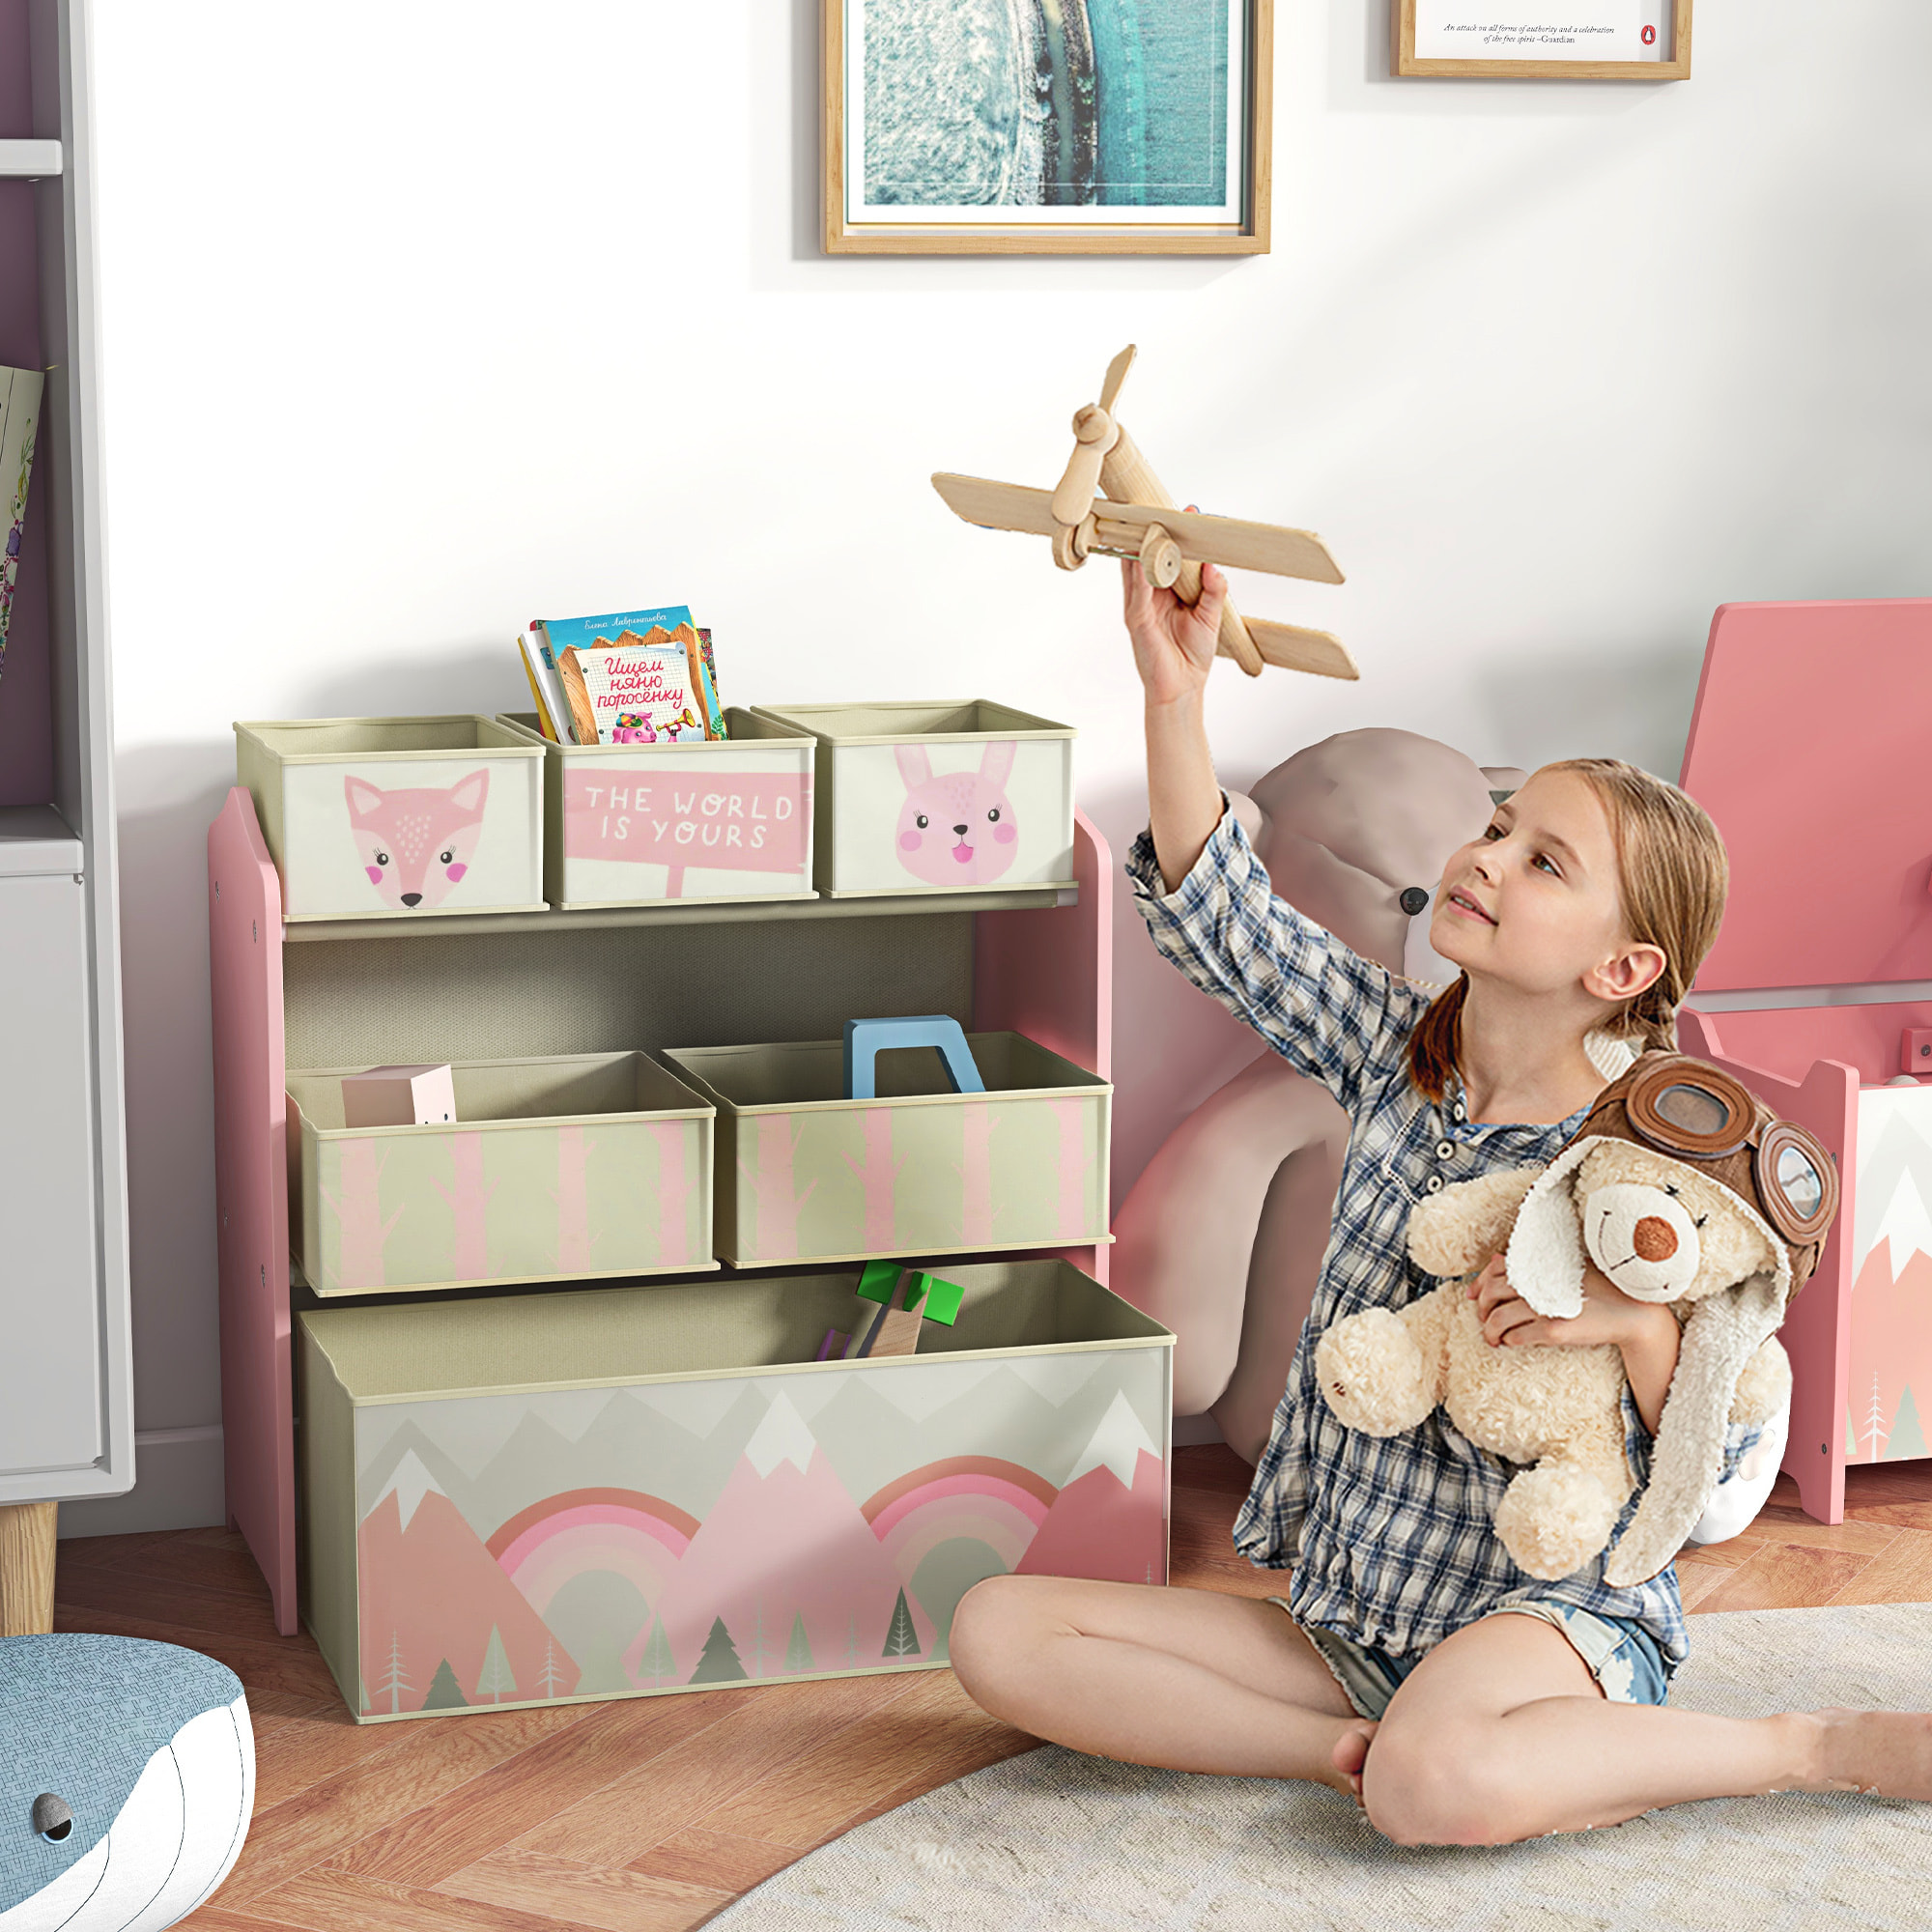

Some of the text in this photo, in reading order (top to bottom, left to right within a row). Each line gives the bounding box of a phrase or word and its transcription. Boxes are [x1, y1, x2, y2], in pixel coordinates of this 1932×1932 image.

[1443, 23, 1455, 32] An
[1497, 24, 1518, 34] forms
[1519, 25, 1527, 34] of
[1526, 25, 1557, 35] authority
[1483, 35, 1492, 44] of
[1502, 35, 1516, 44] free
[1517, 35, 1536, 44] spirit
[584, 619, 609, 631] Елена
[605, 657, 665, 677] Ищем
[610, 673, 664, 692] няню
[597, 687, 684, 710] поросёнку
[584, 785, 793, 821] THE WORLD
[601, 815, 769, 849] IS YOURS
